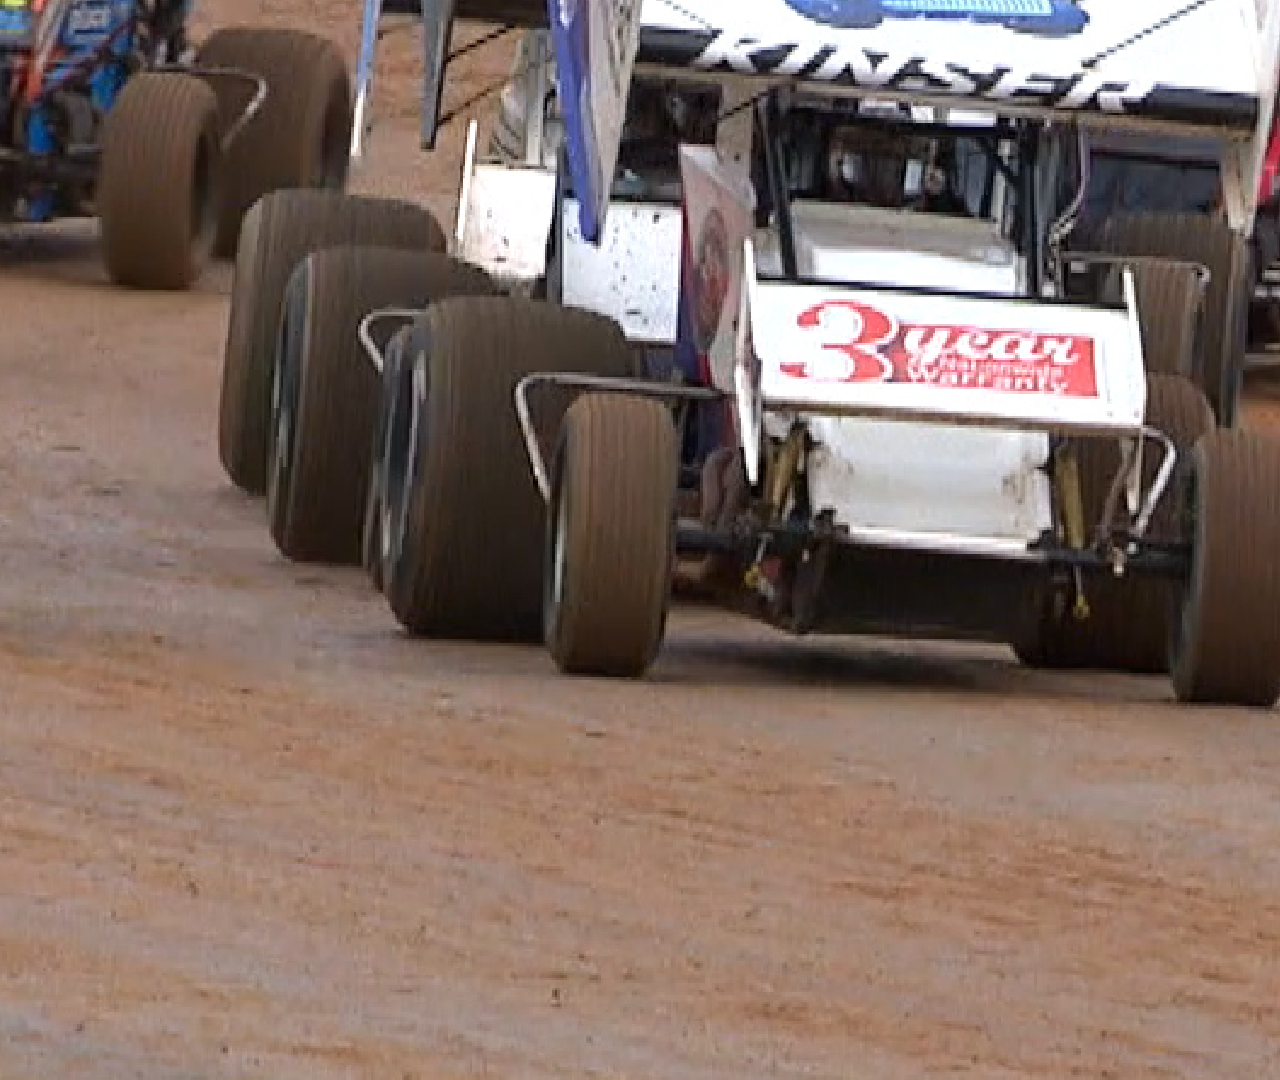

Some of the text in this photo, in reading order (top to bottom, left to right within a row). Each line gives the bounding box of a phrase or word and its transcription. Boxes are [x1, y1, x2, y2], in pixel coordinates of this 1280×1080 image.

[693, 23, 1161, 114] KINSER
[778, 299, 1081, 386] 3 year
